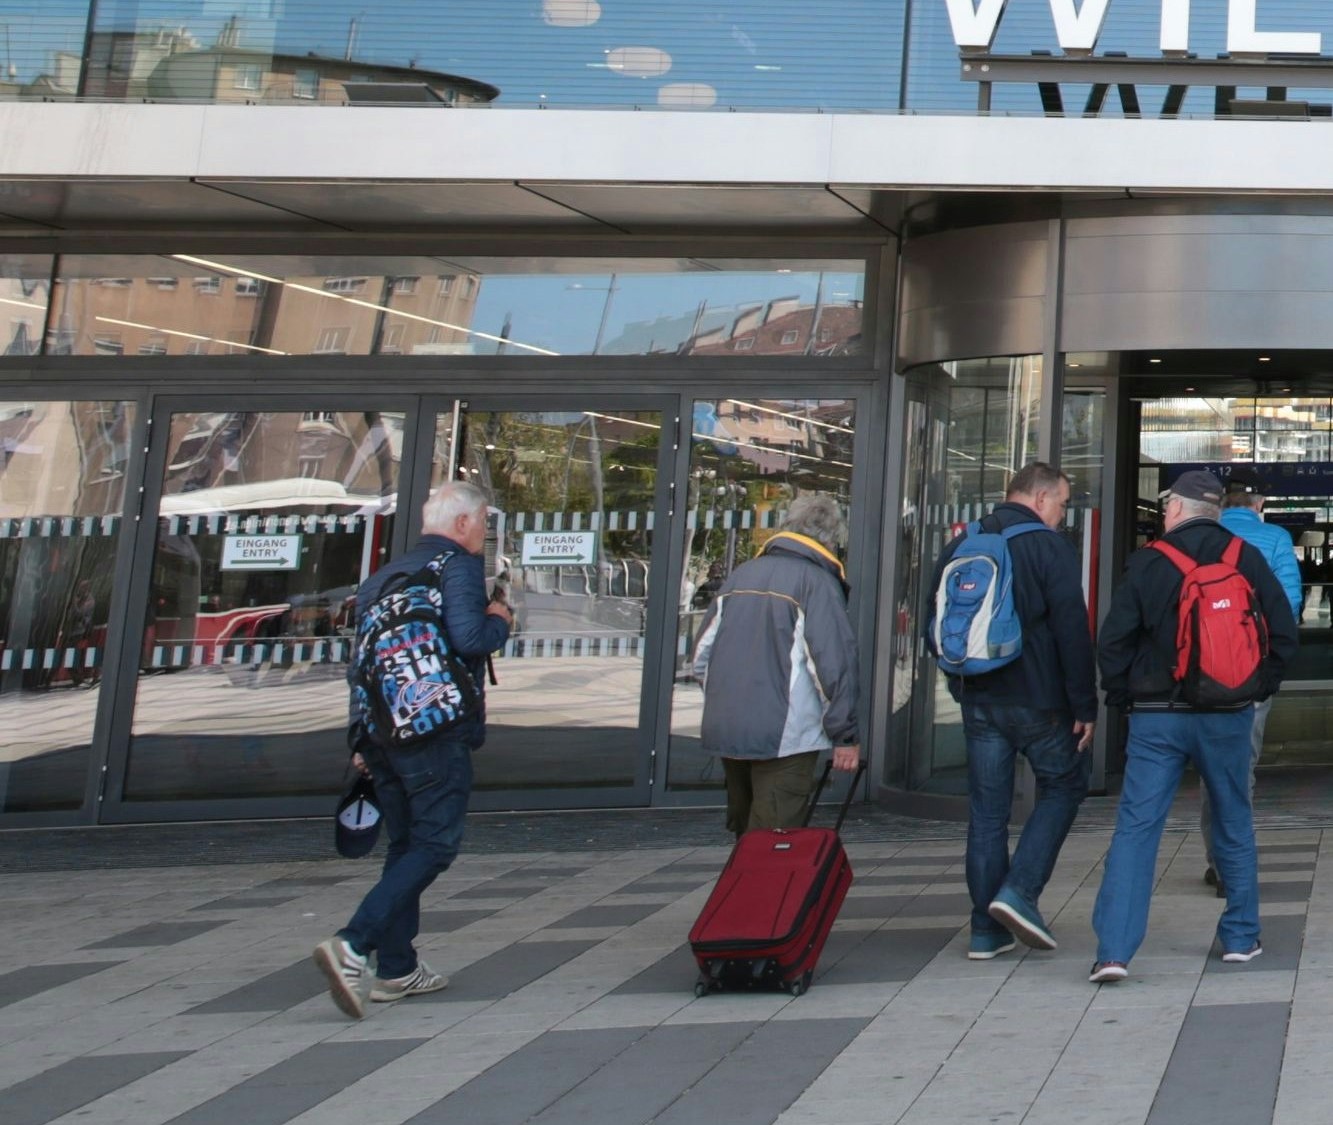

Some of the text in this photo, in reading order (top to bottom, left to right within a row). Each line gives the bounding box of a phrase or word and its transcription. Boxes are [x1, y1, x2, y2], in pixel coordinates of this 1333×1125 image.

[235, 538, 288, 549] EINGANG
[534, 535, 584, 545] EINGANG
[242, 549, 279, 558] ENTRY
[541, 545, 575, 554] ENTRY
